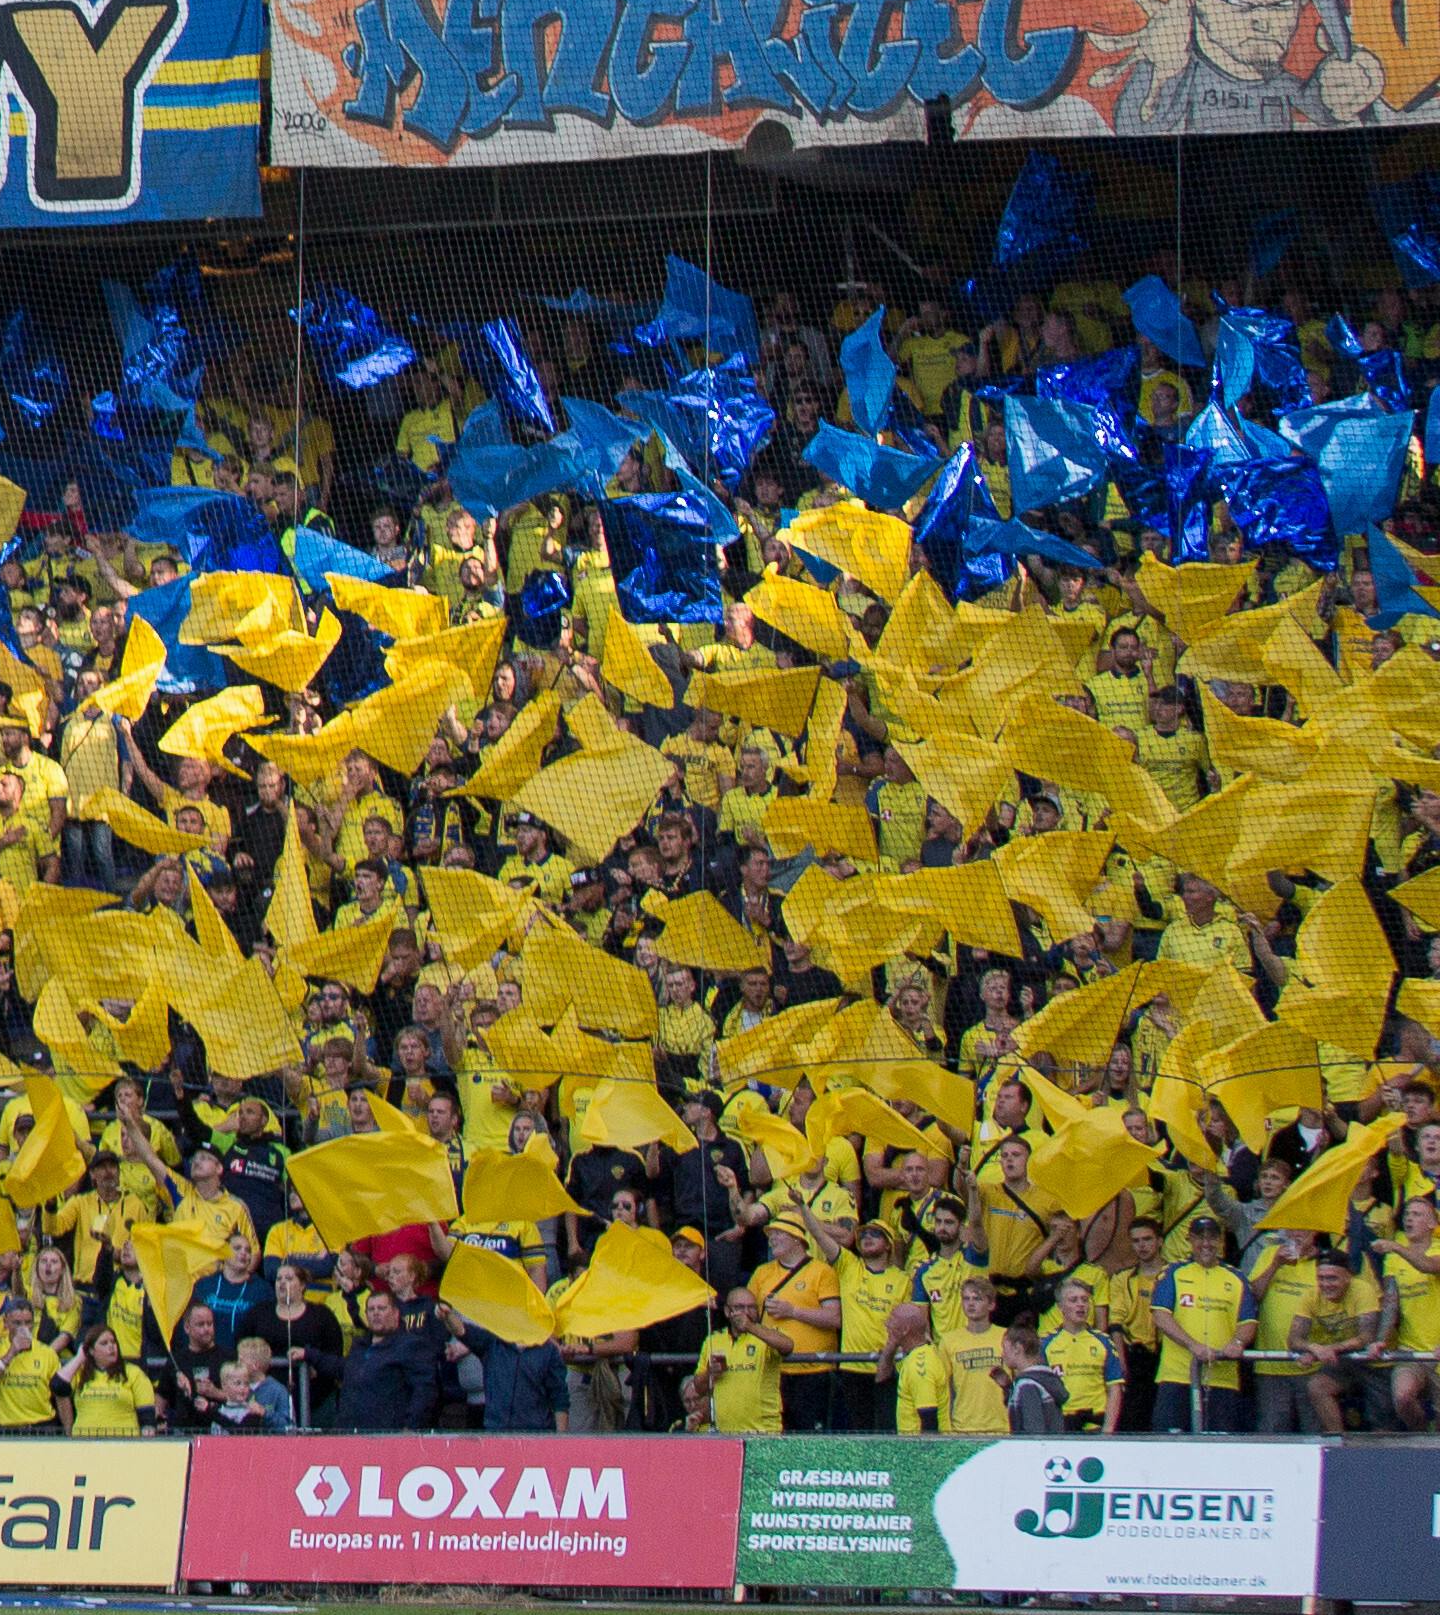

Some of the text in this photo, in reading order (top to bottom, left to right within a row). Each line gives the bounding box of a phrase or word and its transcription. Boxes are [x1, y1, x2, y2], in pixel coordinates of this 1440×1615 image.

[779, 1470, 891, 1486] GRÆSBANER
[358, 1465, 628, 1520] LOXAM
[771, 1492, 896, 1509] HYBRIDBANER
[750, 1513, 913, 1531] KUNSTSTOFBANER
[1106, 1524, 1273, 1540] FODBOLDBANER.DK
[289, 1528, 374, 1553] Europas
[378, 1533, 405, 1551] nr.
[412, 1532, 421, 1550] 1
[439, 1530, 627, 1557] materieludlejning
[748, 1534, 913, 1554] SPORTSBELYSNING
[1105, 1573, 1268, 1588] www.fodboldbaner.dk
